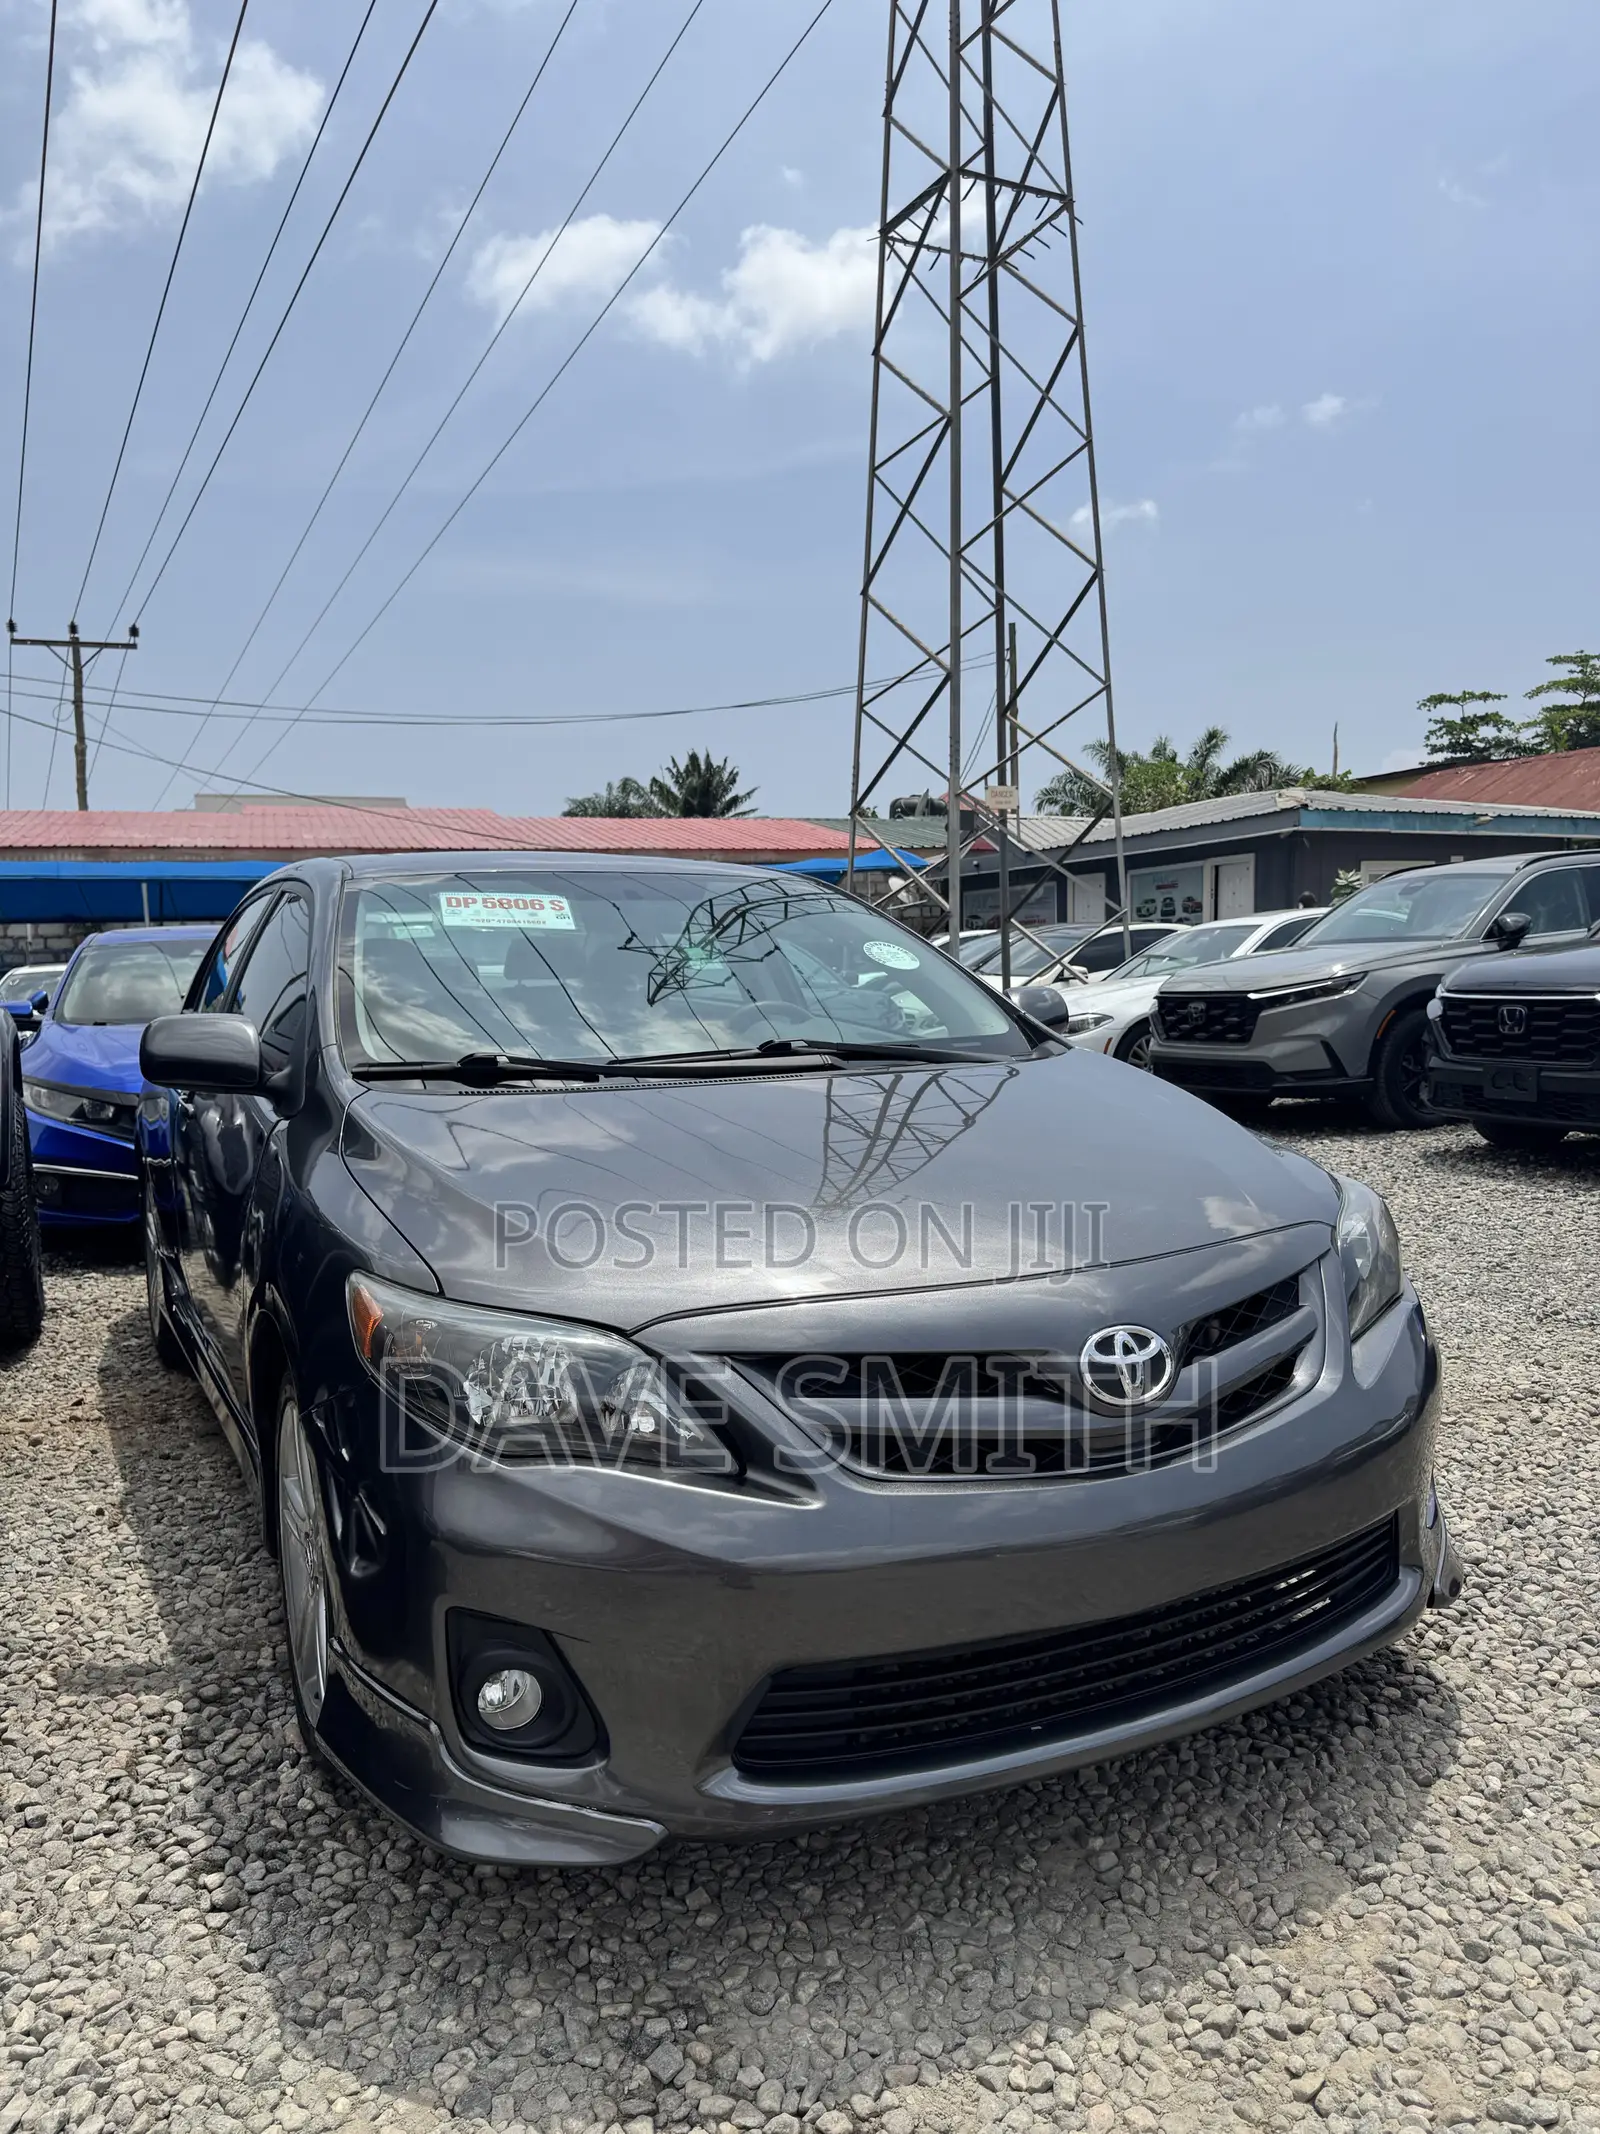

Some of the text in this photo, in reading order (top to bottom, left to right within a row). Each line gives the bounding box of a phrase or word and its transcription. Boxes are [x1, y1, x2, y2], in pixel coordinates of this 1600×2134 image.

[446, 896, 566, 911] DP 5806 S
